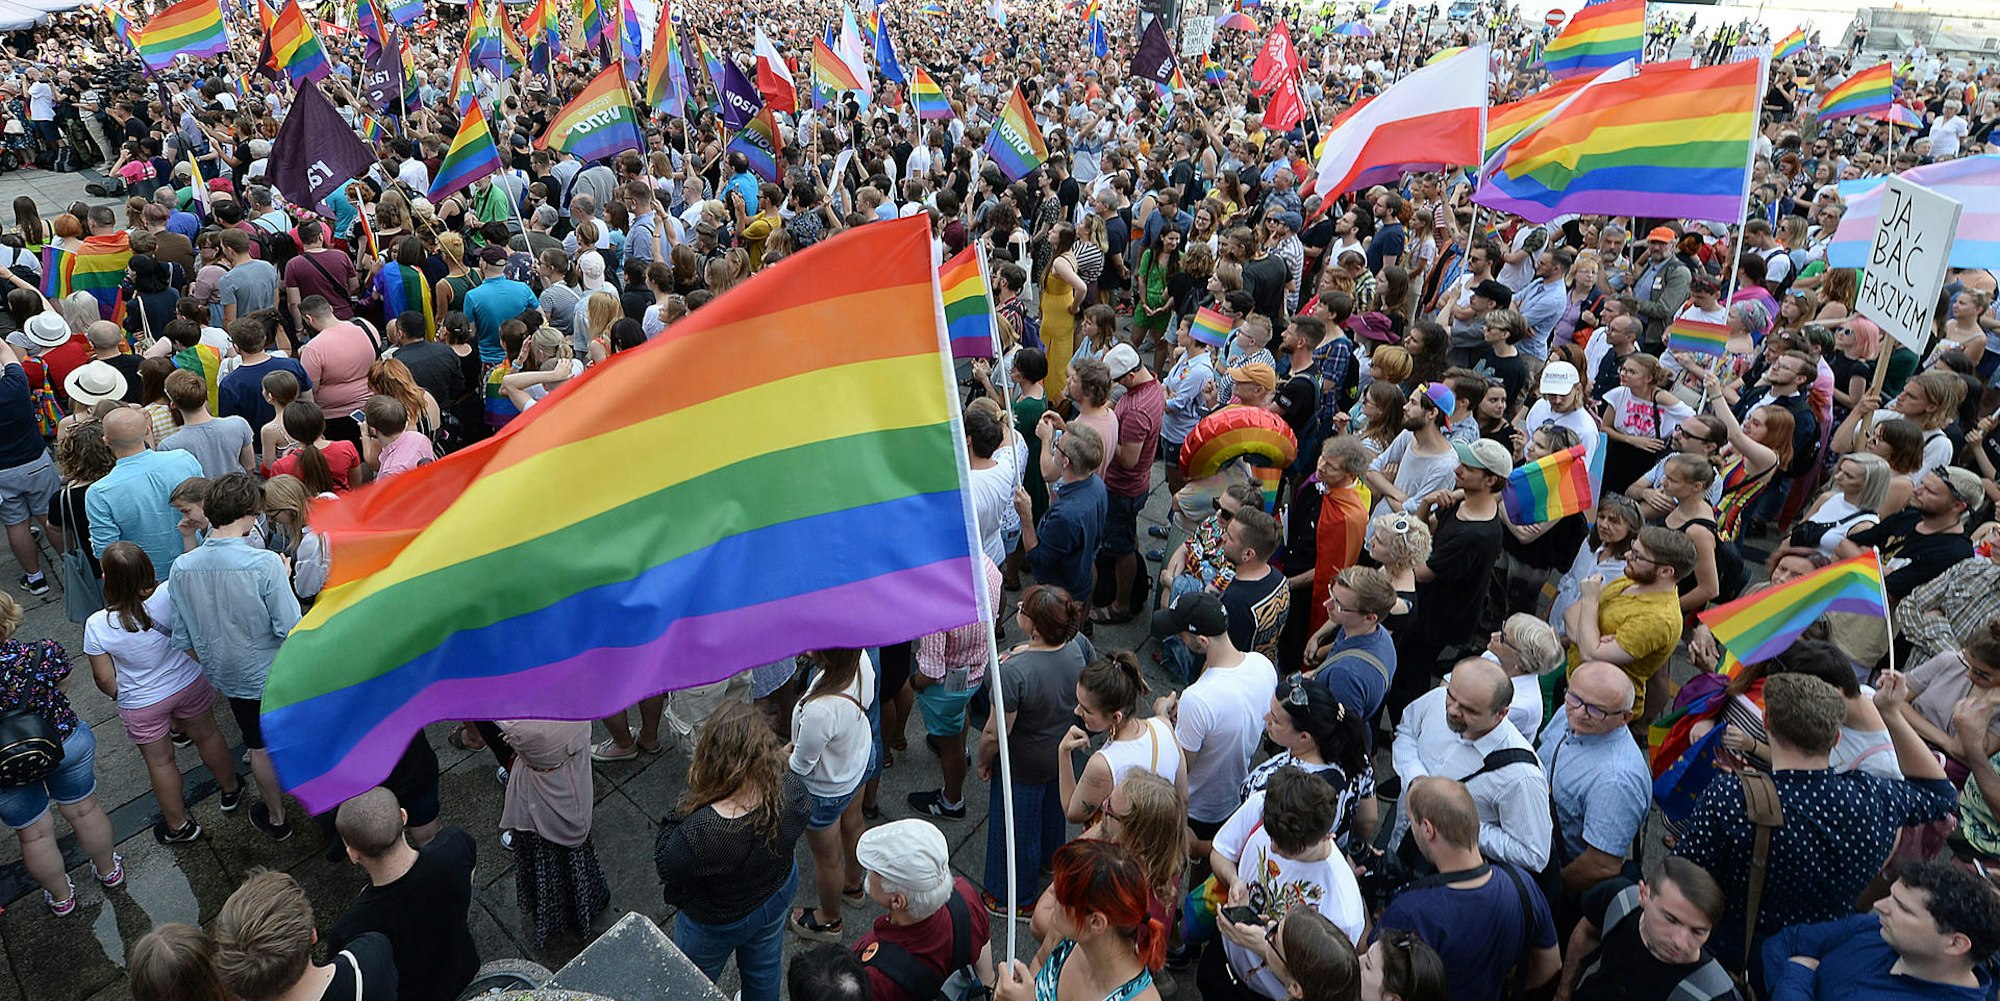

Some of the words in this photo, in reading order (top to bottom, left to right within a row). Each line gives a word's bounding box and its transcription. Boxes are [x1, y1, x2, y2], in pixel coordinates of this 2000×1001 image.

[1882, 188, 1913, 239] JA
[1873, 228, 1924, 288] BAĆ
[1861, 270, 1928, 339] FASZYZM
